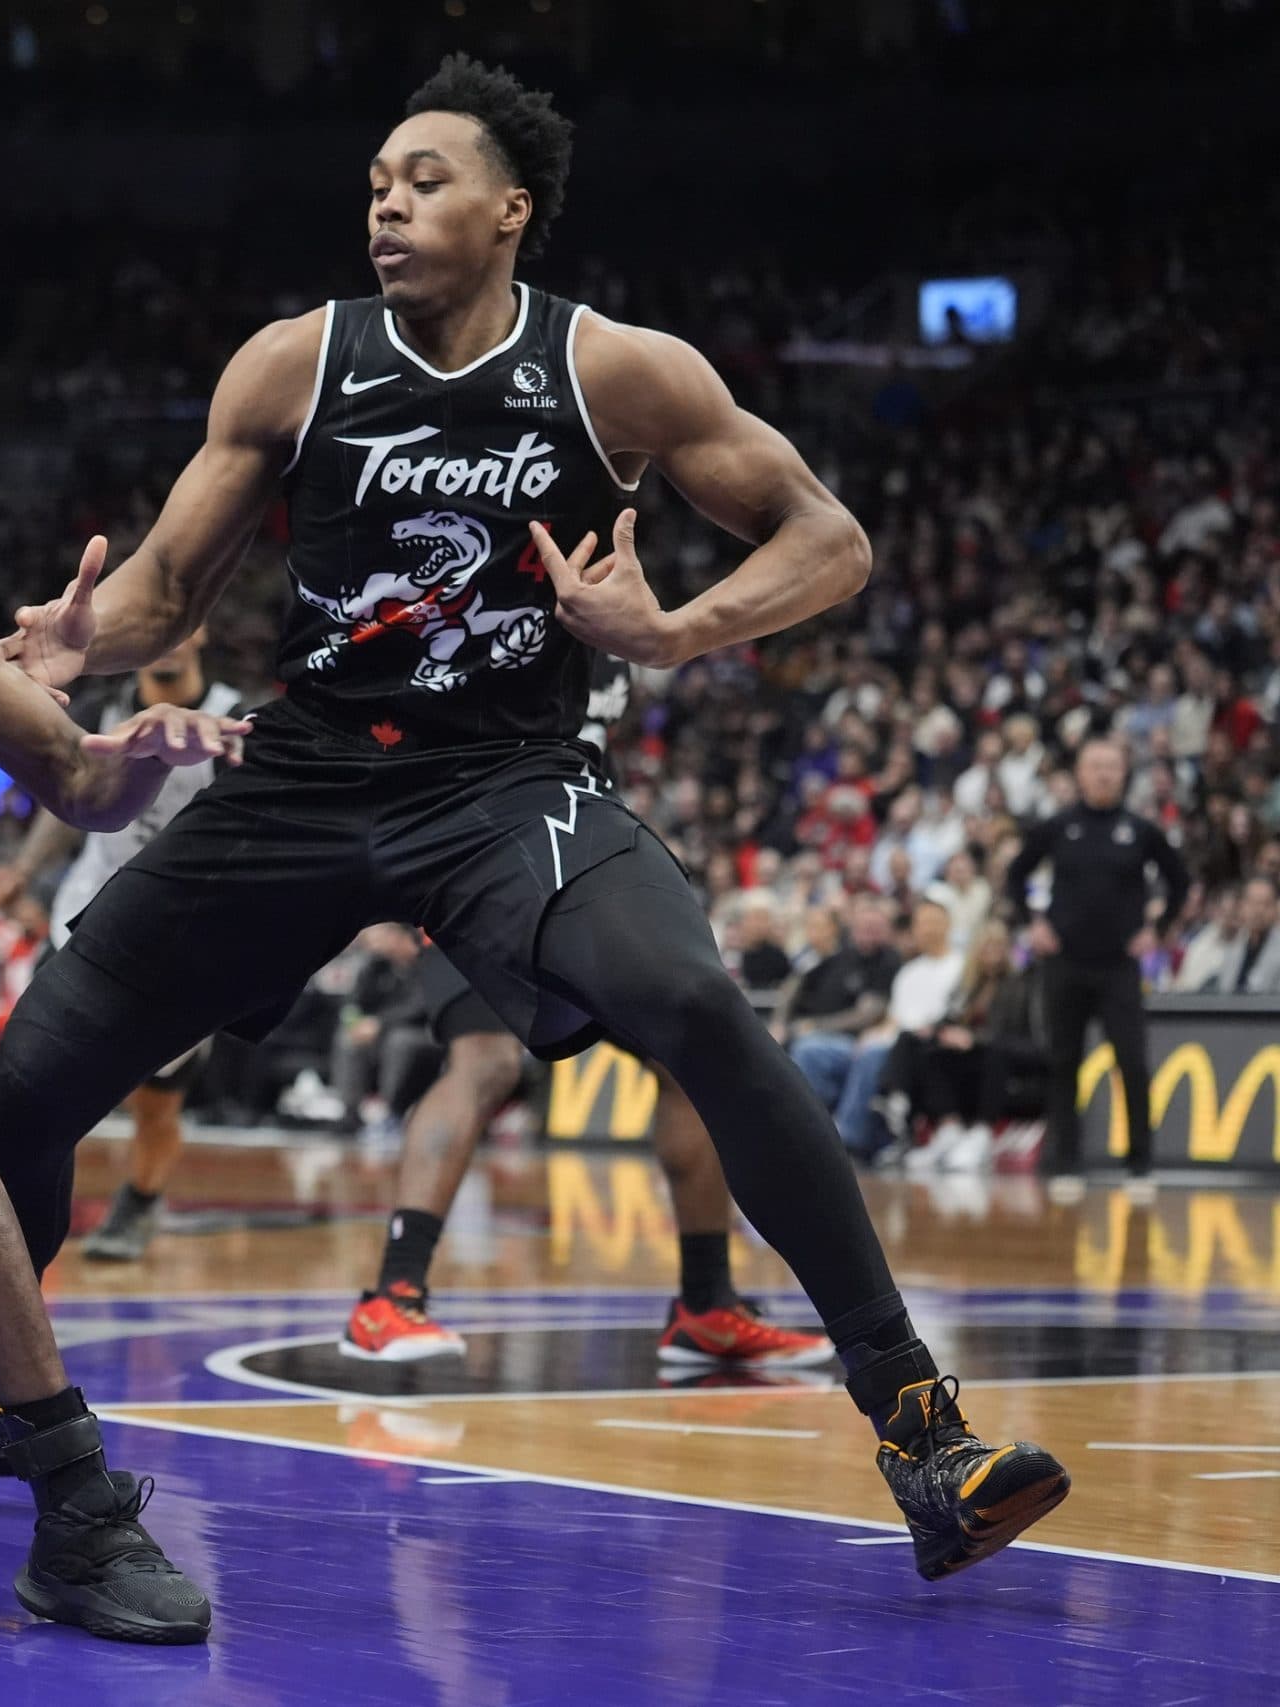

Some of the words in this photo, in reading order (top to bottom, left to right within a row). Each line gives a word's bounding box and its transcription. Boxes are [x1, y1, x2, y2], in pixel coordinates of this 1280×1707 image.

[504, 396, 531, 409] Sun
[533, 396, 558, 409] Life
[333, 425, 561, 508] Toronto
[517, 517, 553, 583] 4
